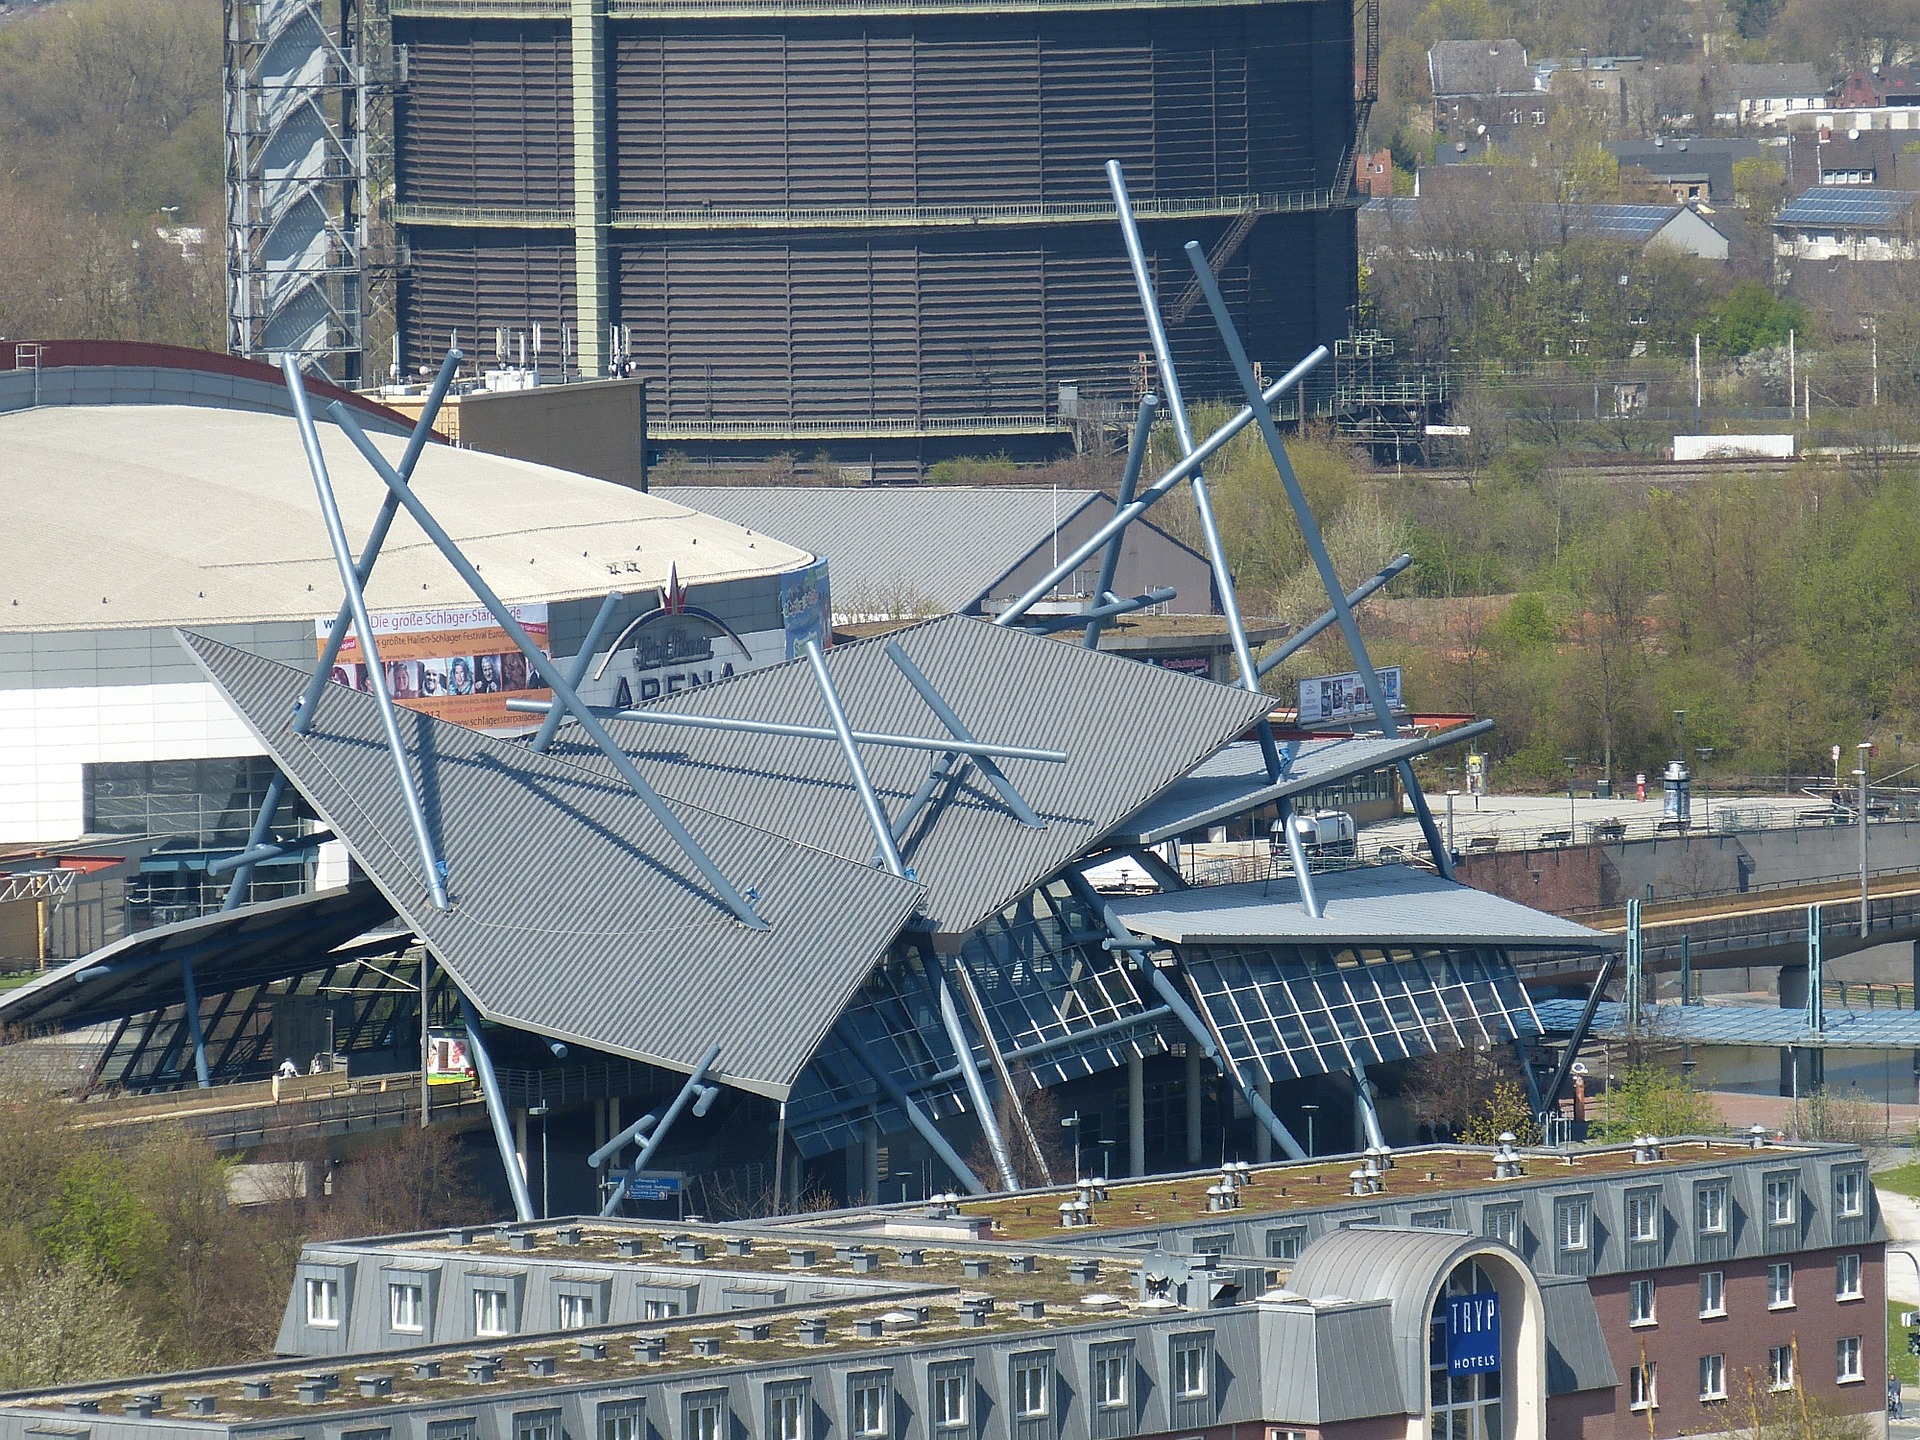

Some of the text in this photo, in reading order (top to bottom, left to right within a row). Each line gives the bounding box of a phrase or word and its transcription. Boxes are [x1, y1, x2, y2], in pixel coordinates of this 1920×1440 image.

[371, 615, 389, 629] Die
[391, 613, 423, 631] große
[1451, 1299, 1495, 1335] TRYP
[1454, 1354, 1495, 1370] HOTELS
